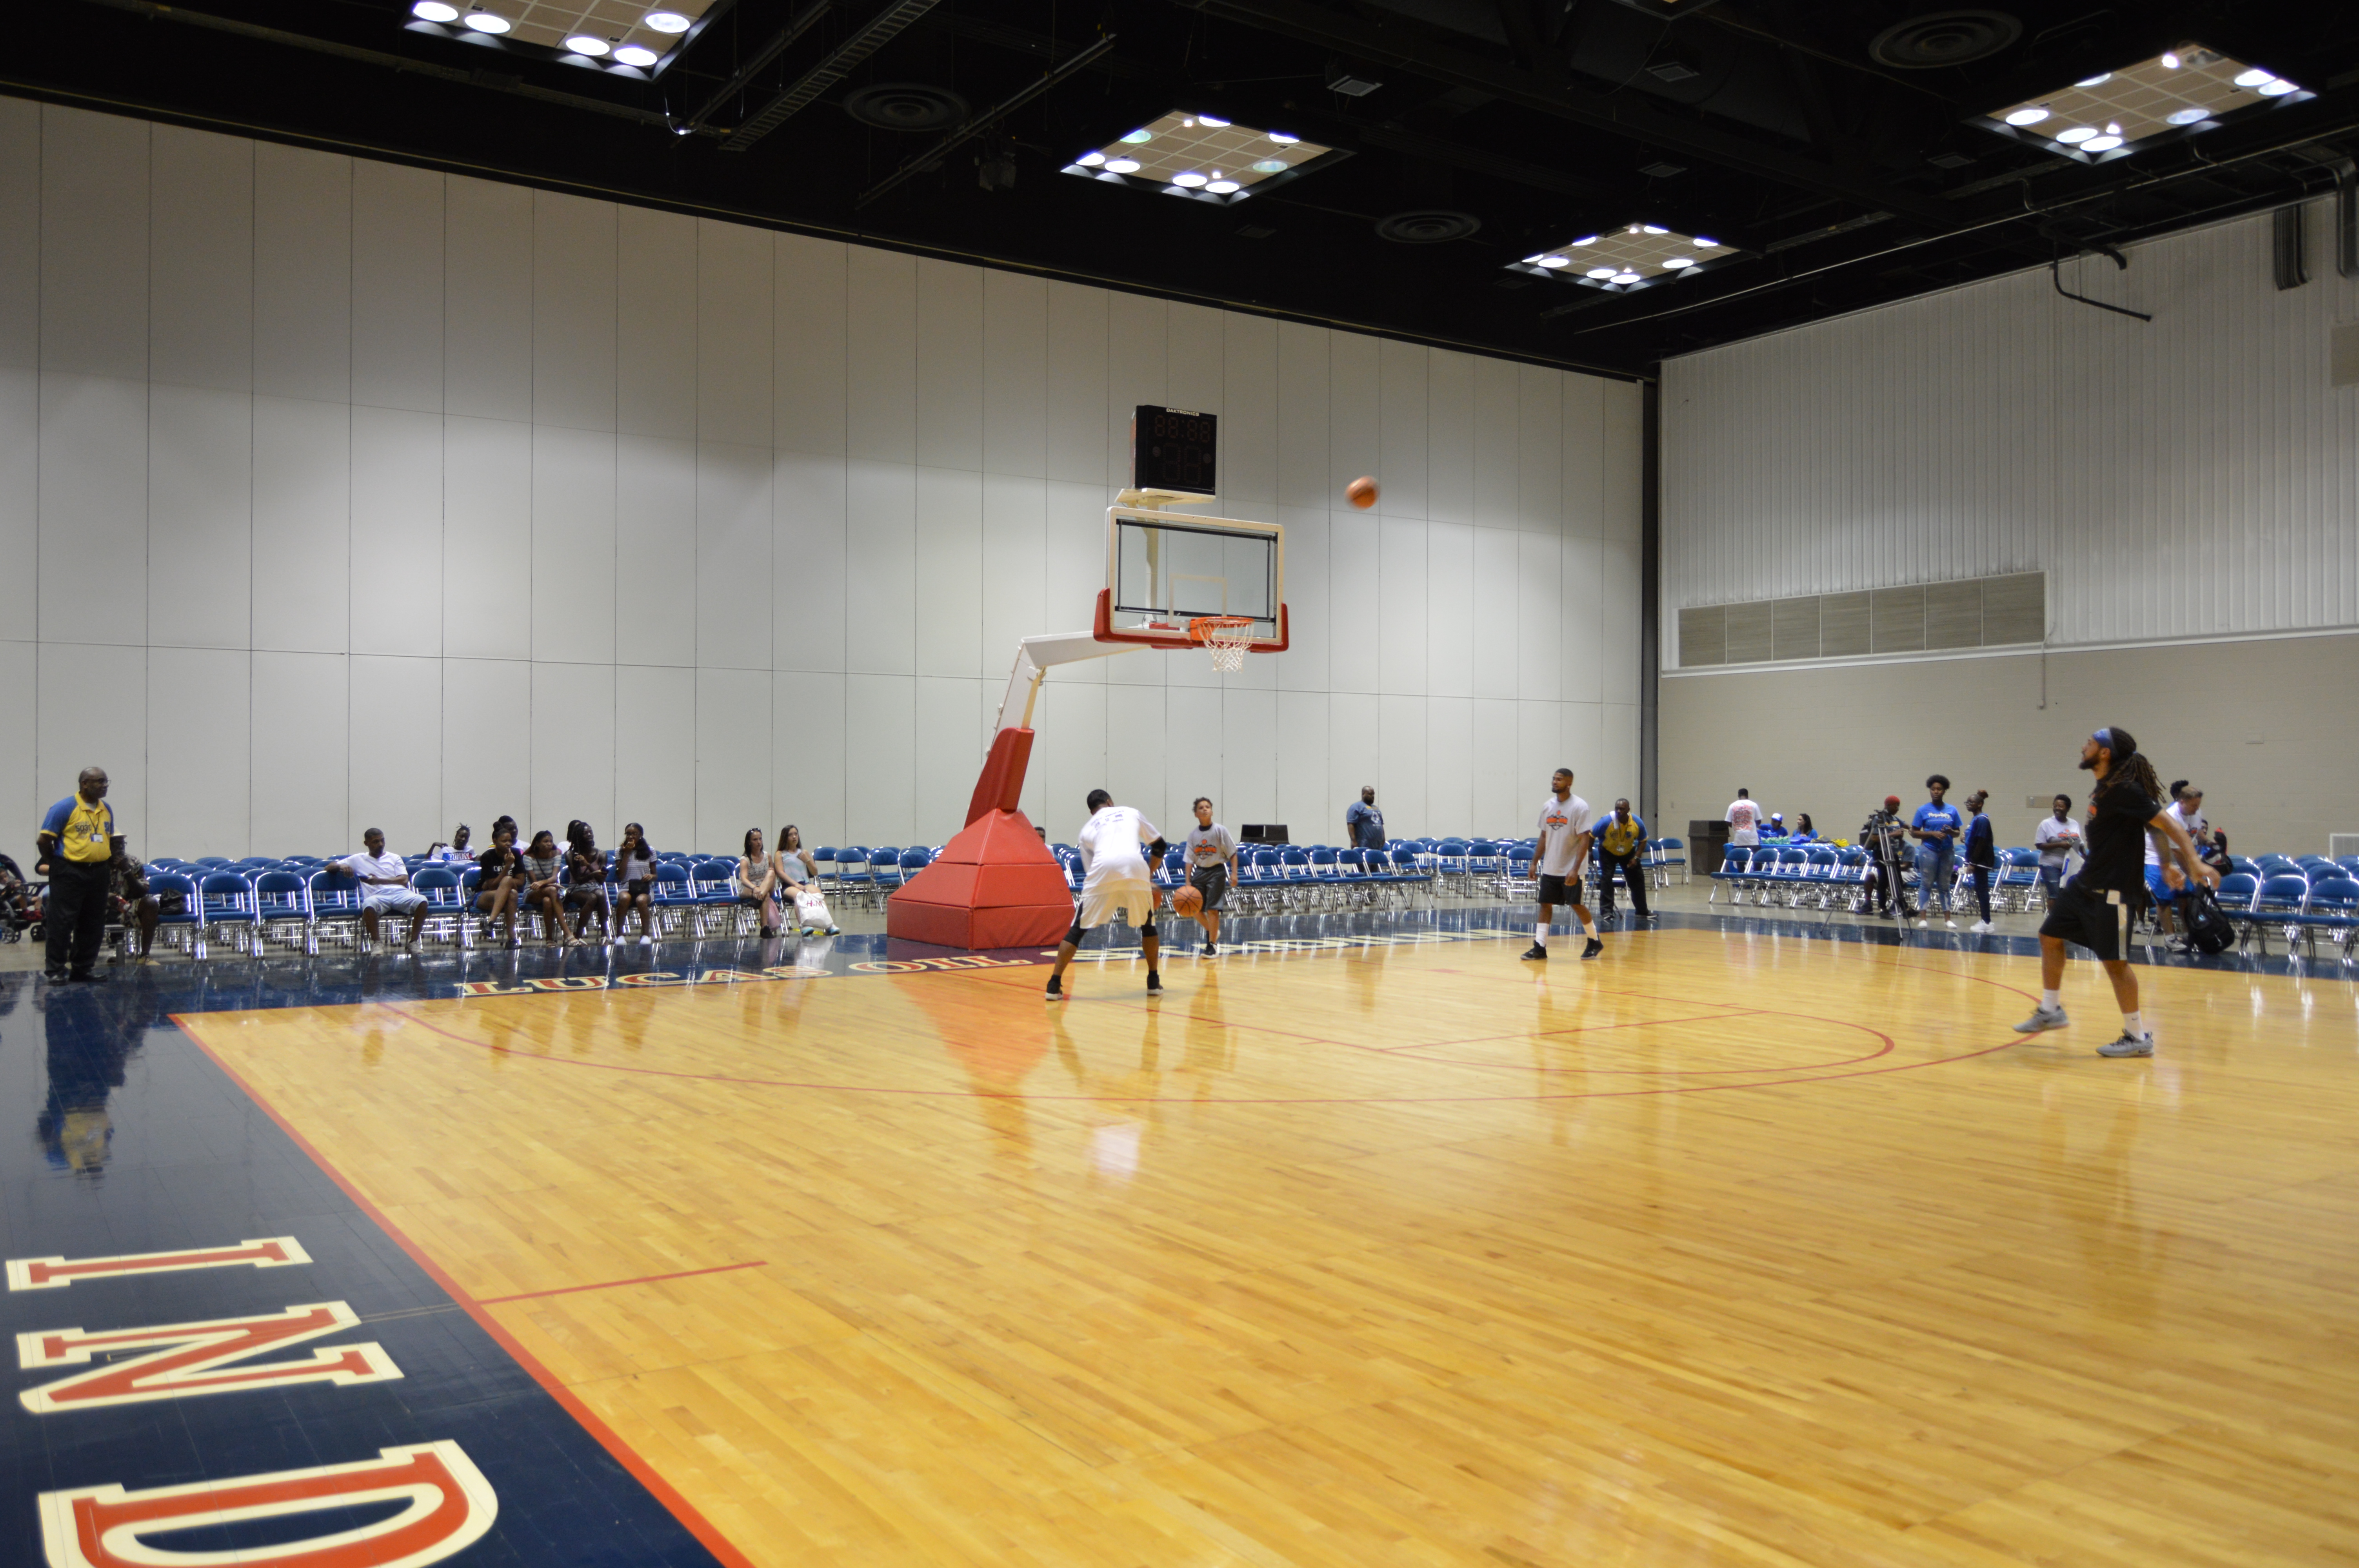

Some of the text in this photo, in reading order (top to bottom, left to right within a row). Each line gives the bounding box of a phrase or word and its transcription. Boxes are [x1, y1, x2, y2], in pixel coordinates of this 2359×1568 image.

[1166, 408, 1199, 417] DAKTRONICS
[454, 929, 1536, 996] LUCAS OIL STADIUM
